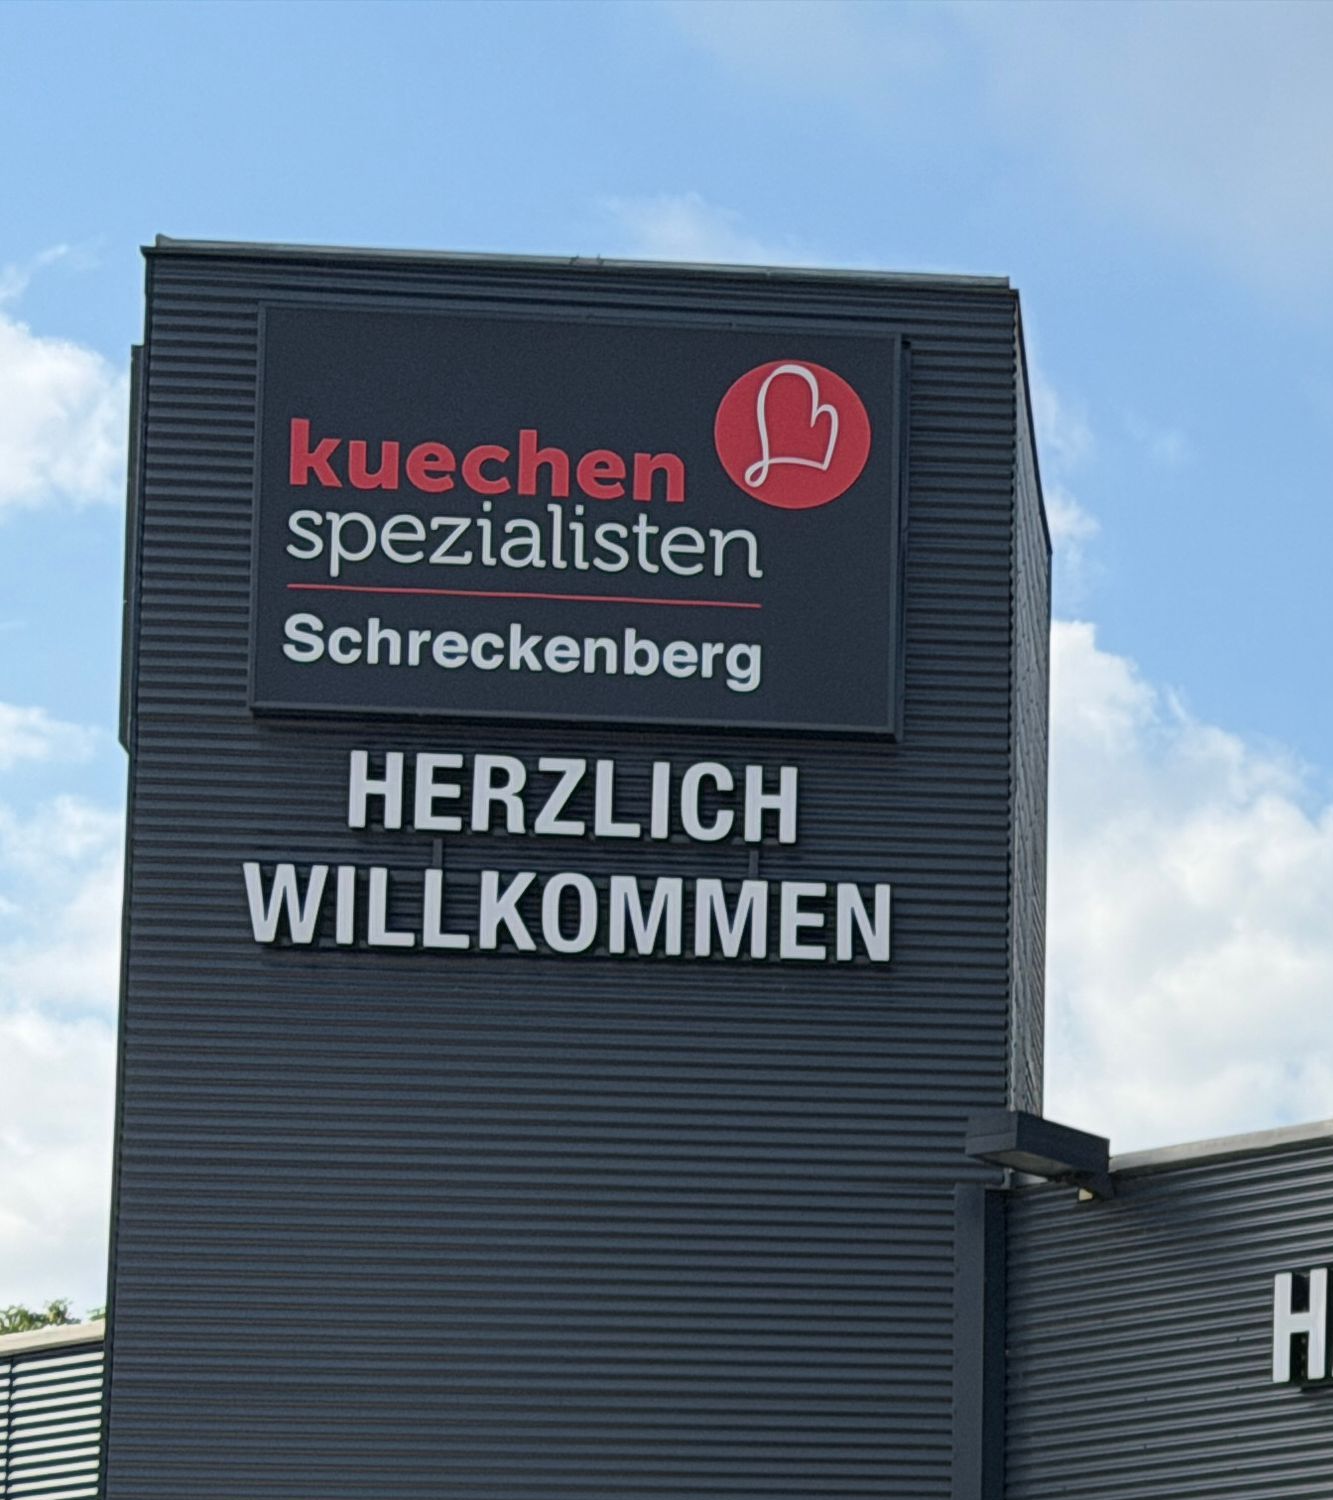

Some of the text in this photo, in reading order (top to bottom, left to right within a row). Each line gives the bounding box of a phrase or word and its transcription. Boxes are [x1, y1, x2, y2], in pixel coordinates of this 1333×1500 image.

[289, 419, 685, 503] kuechen
[286, 502, 764, 578] spezialisten
[282, 613, 763, 692] Schreckenberg
[347, 750, 798, 845] HERZLICH
[243, 863, 892, 962] WILLKOMMEN
